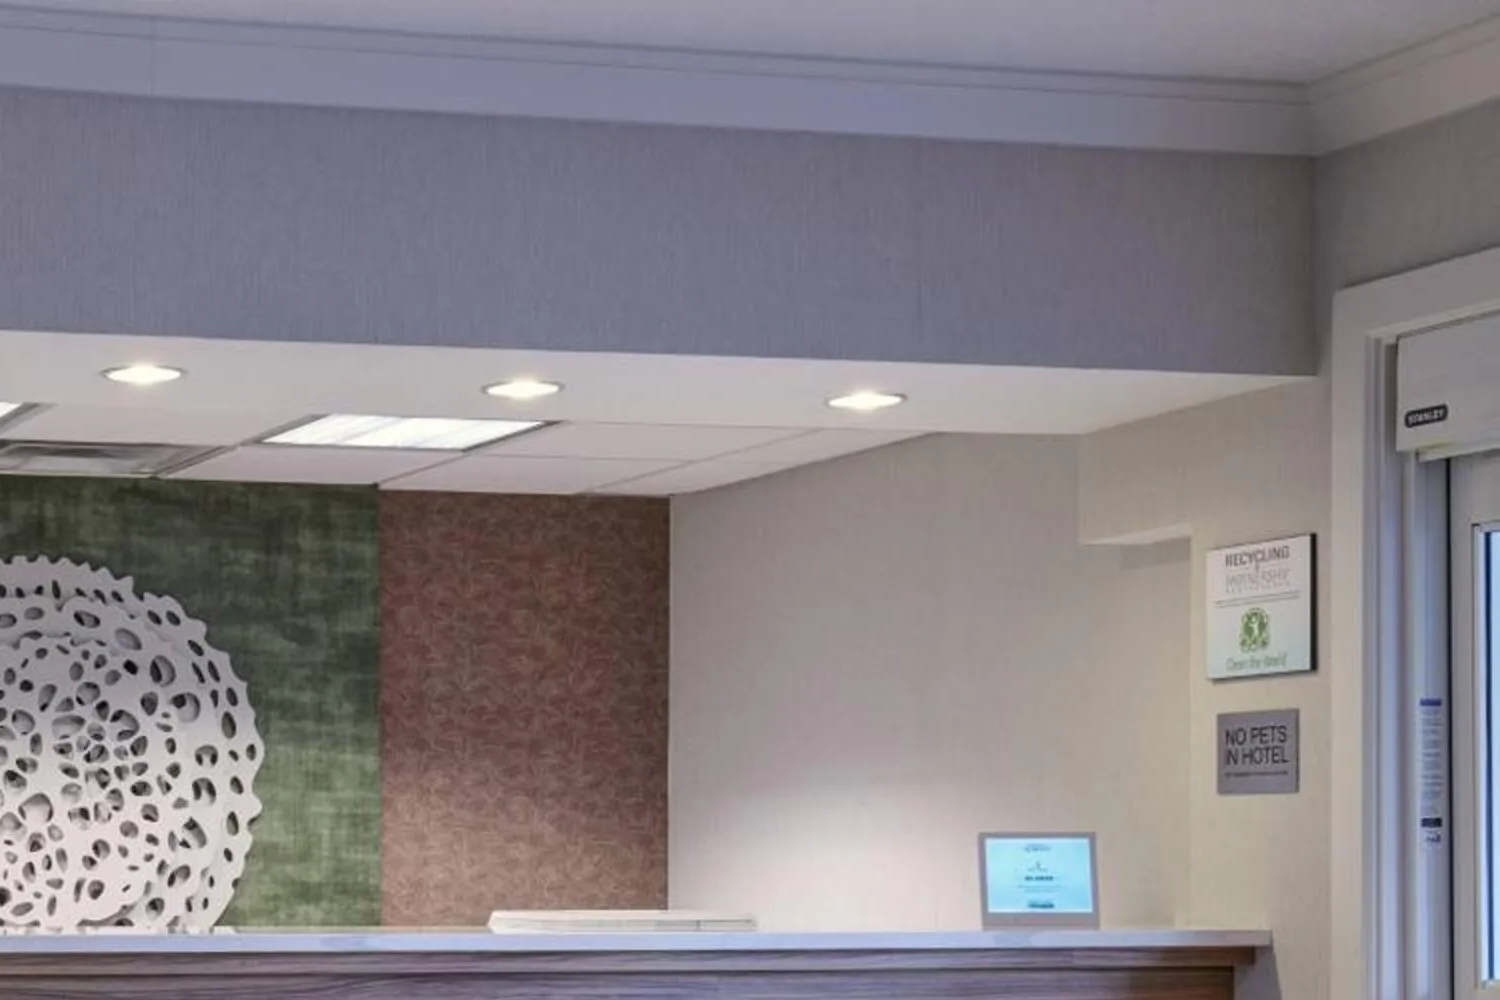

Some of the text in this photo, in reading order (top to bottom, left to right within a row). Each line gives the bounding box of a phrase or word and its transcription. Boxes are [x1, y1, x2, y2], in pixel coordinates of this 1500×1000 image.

[1224, 545, 1291, 567] RECYCLING
[1225, 725, 1287, 746] NO PETS
[1225, 745, 1292, 766] IN HOTEL
